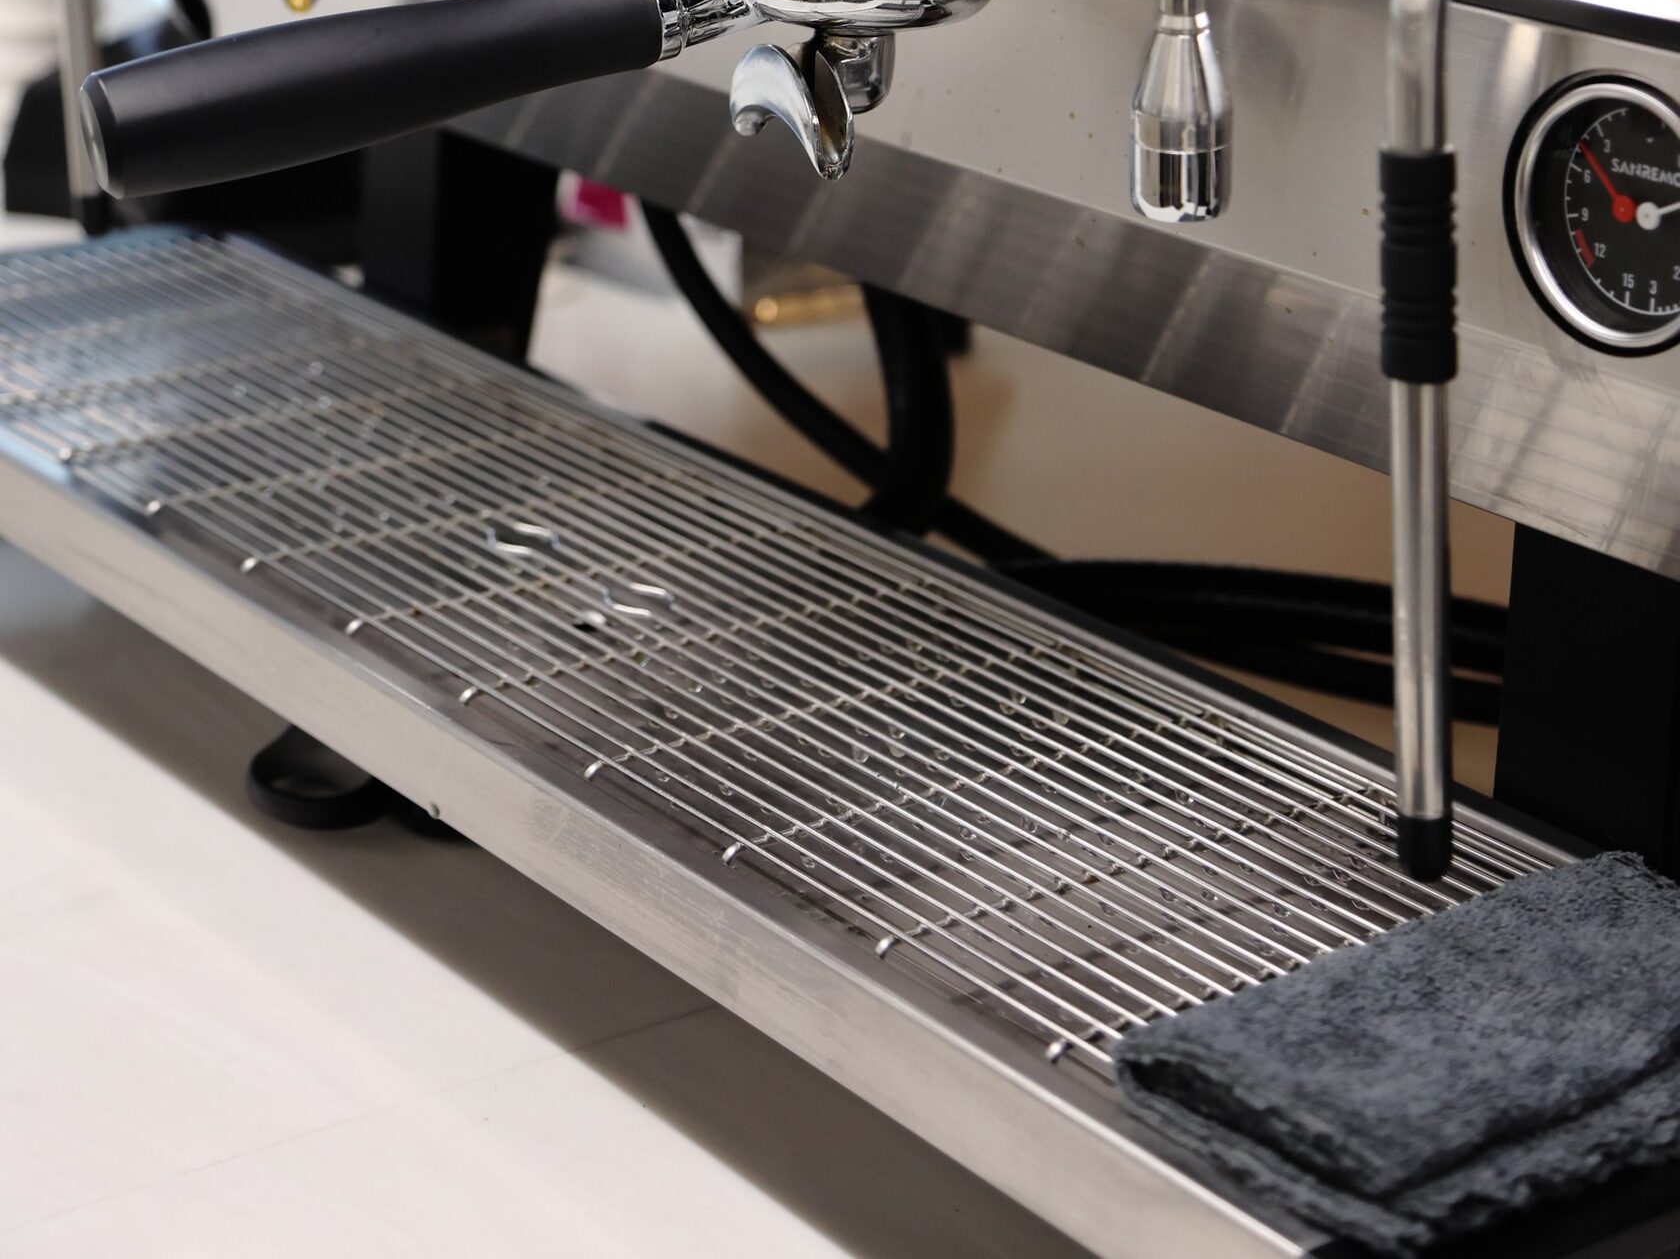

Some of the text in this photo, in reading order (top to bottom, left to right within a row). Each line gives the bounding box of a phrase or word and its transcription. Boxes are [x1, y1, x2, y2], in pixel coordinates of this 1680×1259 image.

[1603, 138, 1611, 154] 3
[1583, 169, 1592, 184] 6
[1581, 207, 1589, 222] 9
[1594, 242, 1606, 258] 12
[1622, 272, 1635, 289] 15
[1649, 280, 1658, 295] 3
